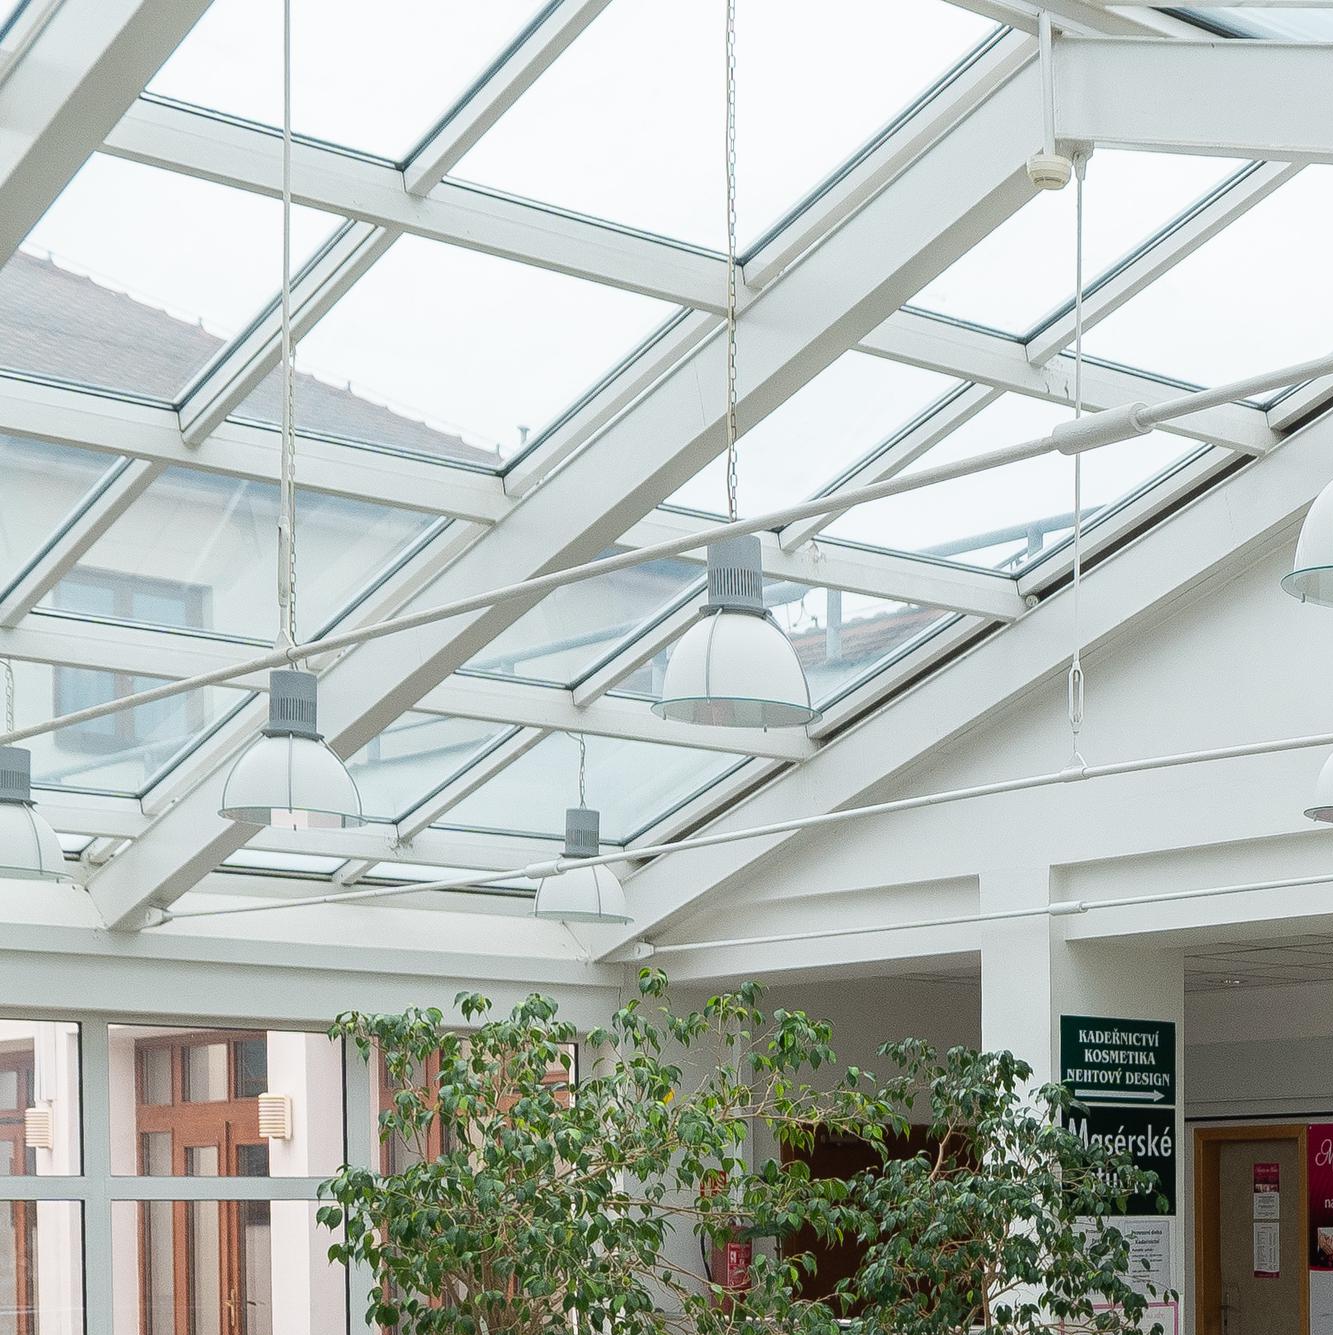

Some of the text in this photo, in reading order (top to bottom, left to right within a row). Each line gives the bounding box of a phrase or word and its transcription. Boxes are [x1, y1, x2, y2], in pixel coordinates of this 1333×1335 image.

[1079, 1028, 1160, 1047] KADEŘNICTVÍ
[1084, 1049, 1156, 1065] KOSMETIKA
[1066, 1067, 1171, 1087] NEHTOVÝ DESIGN
